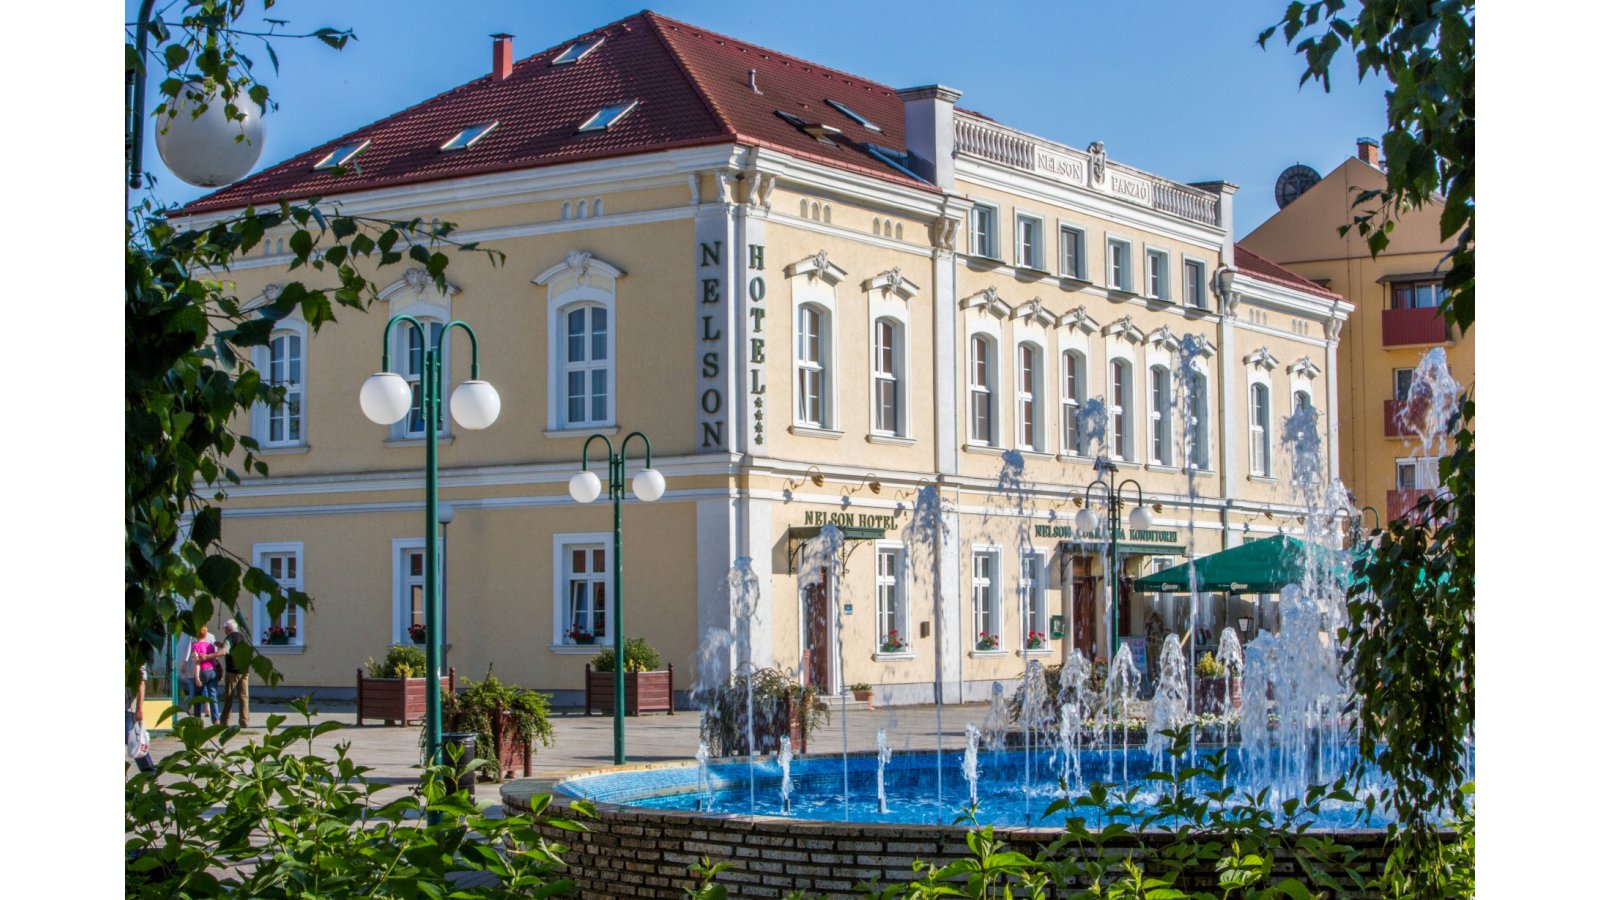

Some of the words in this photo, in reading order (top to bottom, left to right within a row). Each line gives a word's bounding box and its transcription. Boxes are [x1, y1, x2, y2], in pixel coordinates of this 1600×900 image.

[1037, 153, 1080, 180] NELSON
[700, 241, 724, 447] NELSON
[804, 510, 855, 527] NELSON
[858, 514, 898, 530] HOTEL
[1035, 525, 1071, 538] NELSON
